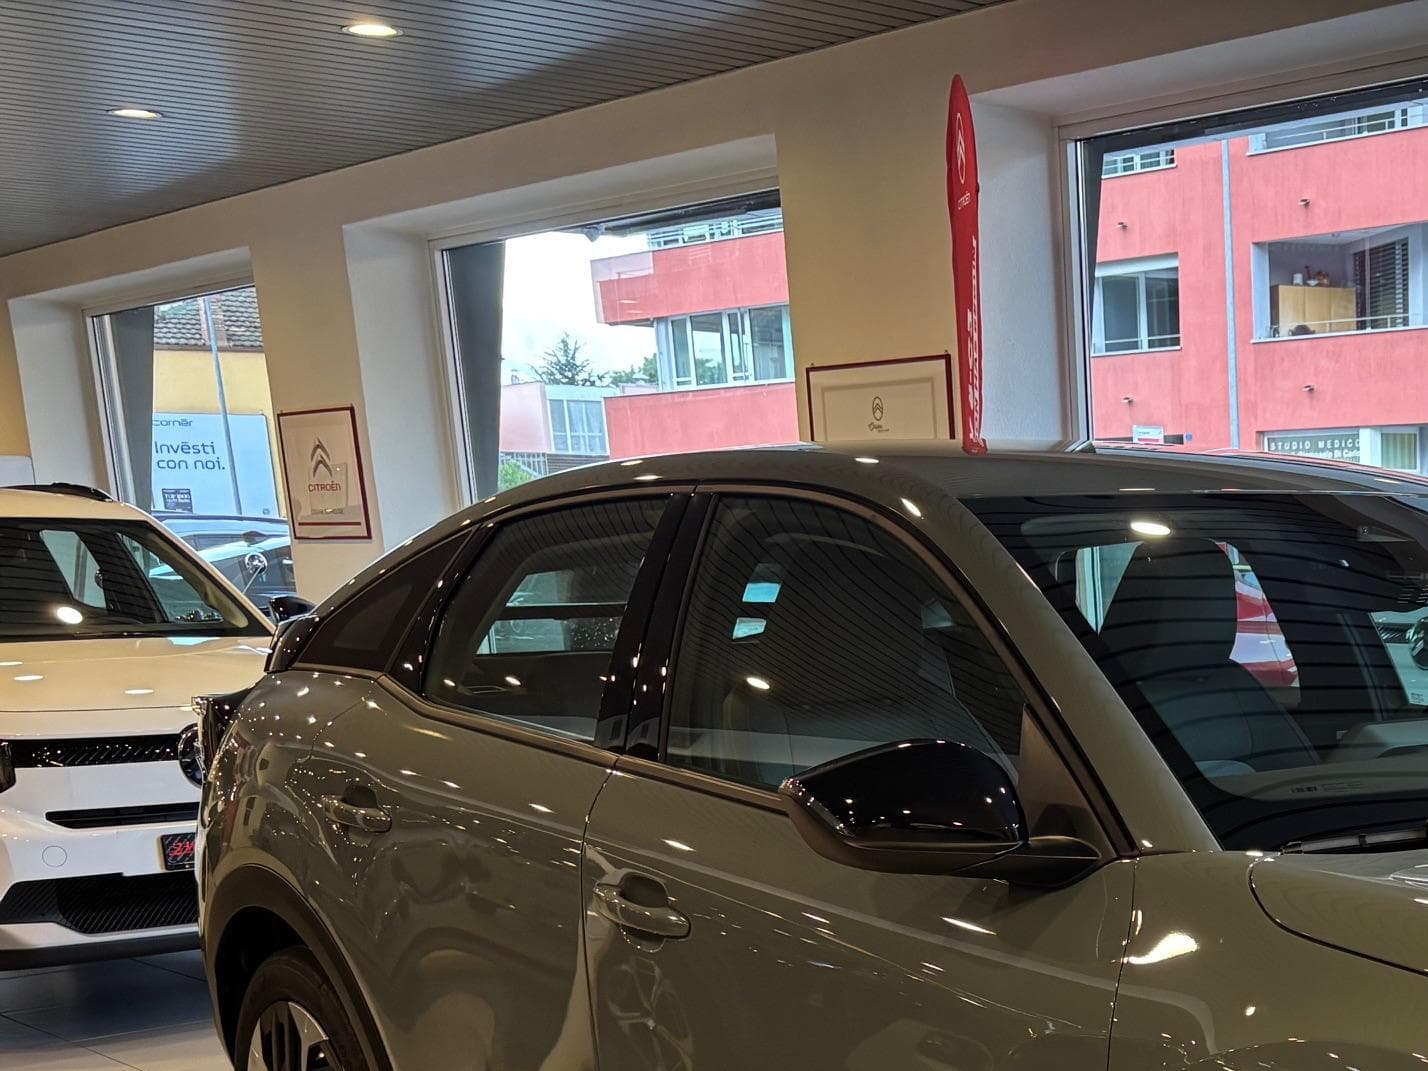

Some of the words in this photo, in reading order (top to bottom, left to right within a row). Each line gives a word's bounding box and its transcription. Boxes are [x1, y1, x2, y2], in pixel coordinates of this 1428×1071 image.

[1270, 441, 1311, 451] STUDIO
[156, 459, 188, 470] con
[193, 456, 226, 471] noi.
